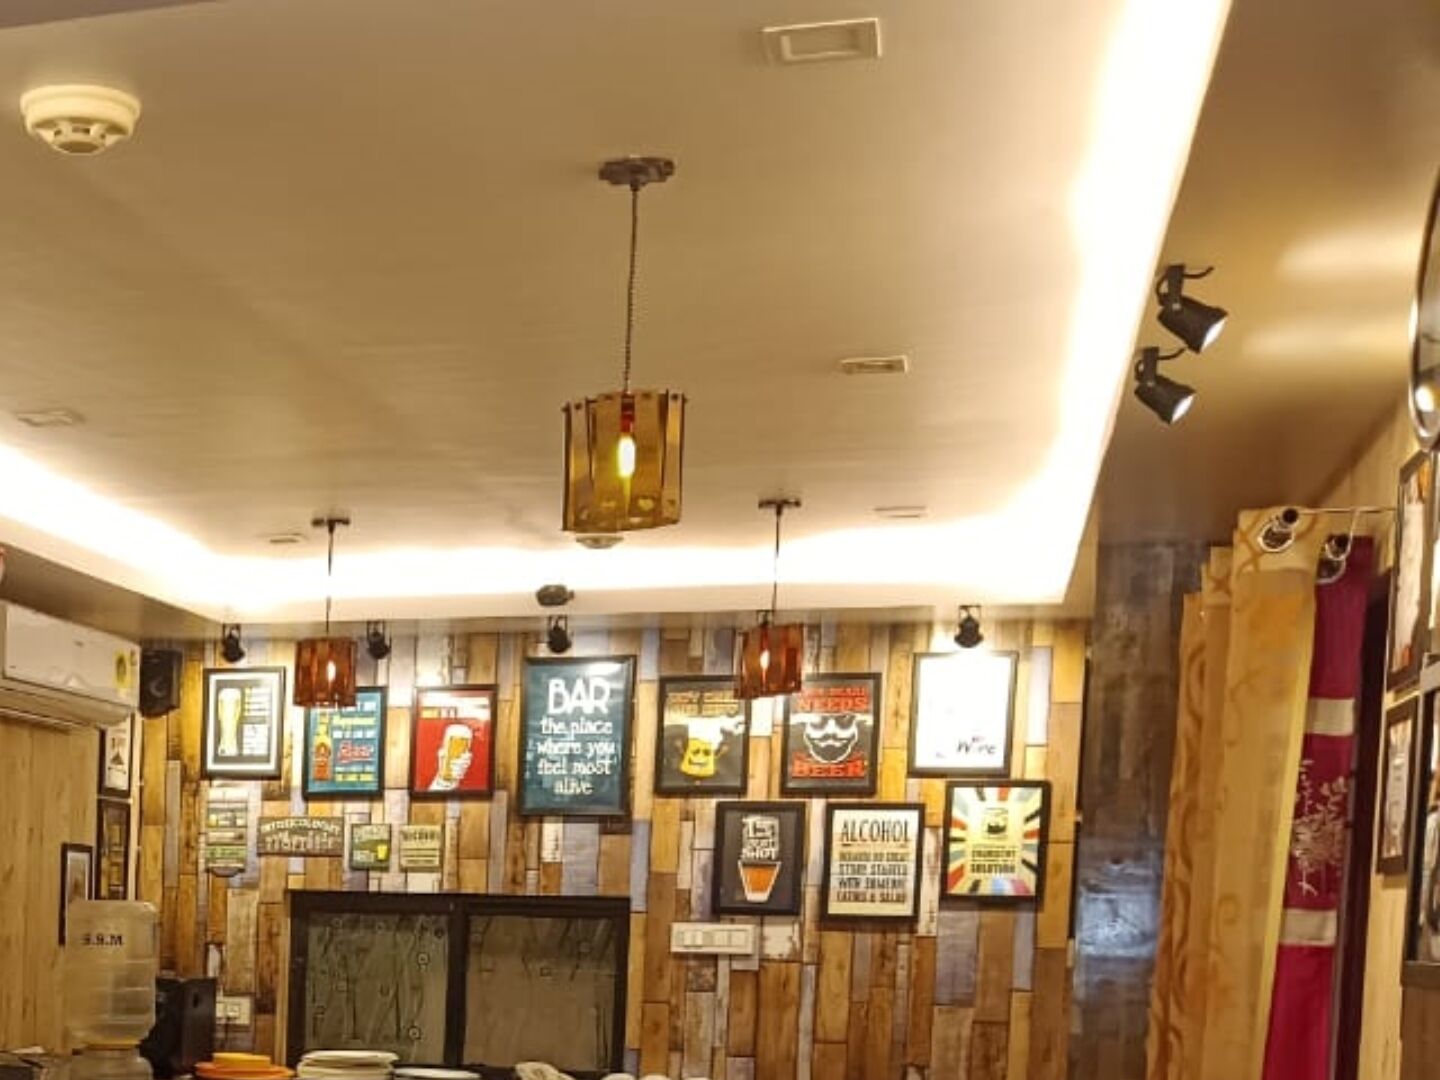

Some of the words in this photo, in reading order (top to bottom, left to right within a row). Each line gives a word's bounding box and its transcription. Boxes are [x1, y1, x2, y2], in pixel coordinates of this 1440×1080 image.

[547, 677, 610, 714] BAR
[796, 697, 868, 713] NEEDS
[540, 715, 568, 735] the
[570, 716, 613, 741] place
[536, 738, 582, 755] where
[585, 741, 615, 760] you
[537, 757, 568, 775] feel
[791, 752, 865, 777] BEER
[553, 778, 594, 795] alive
[840, 818, 910, 842] ALCOHOL
